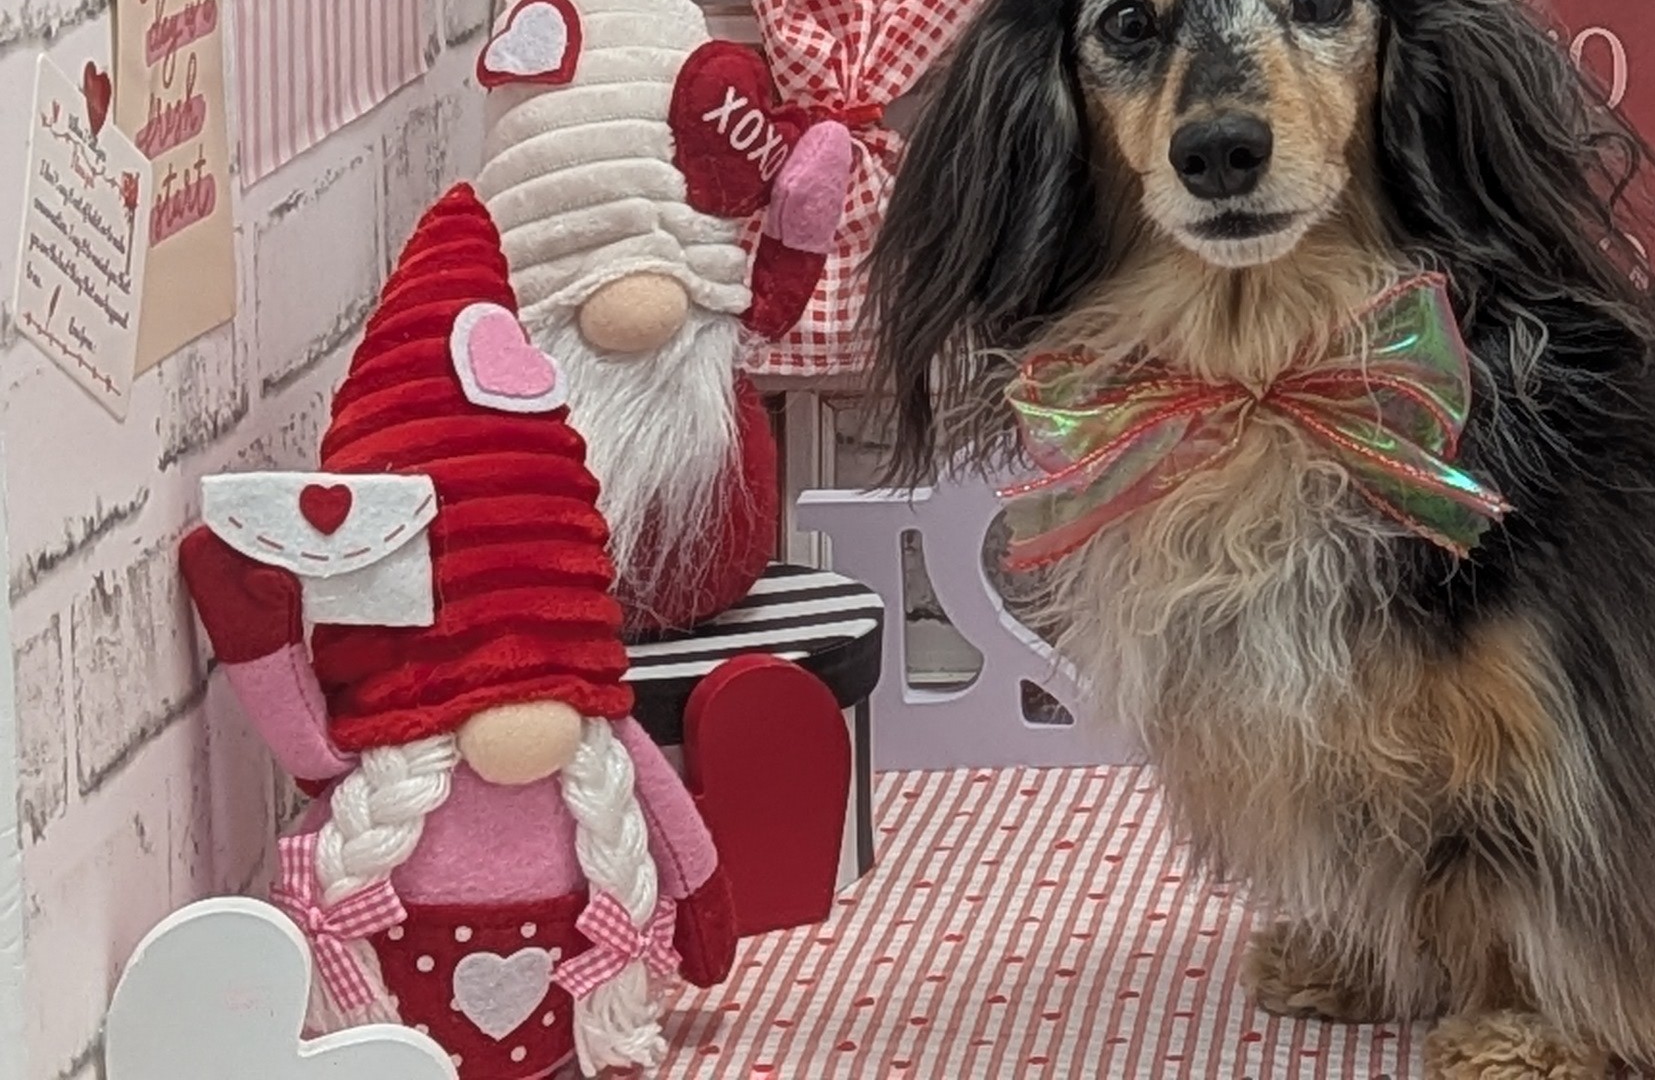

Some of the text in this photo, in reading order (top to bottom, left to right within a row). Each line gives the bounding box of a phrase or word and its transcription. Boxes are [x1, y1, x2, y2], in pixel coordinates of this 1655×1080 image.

[1547, 27, 1628, 110] 0
[702, 85, 788, 182] XOXO
[154, 144, 211, 240] start
